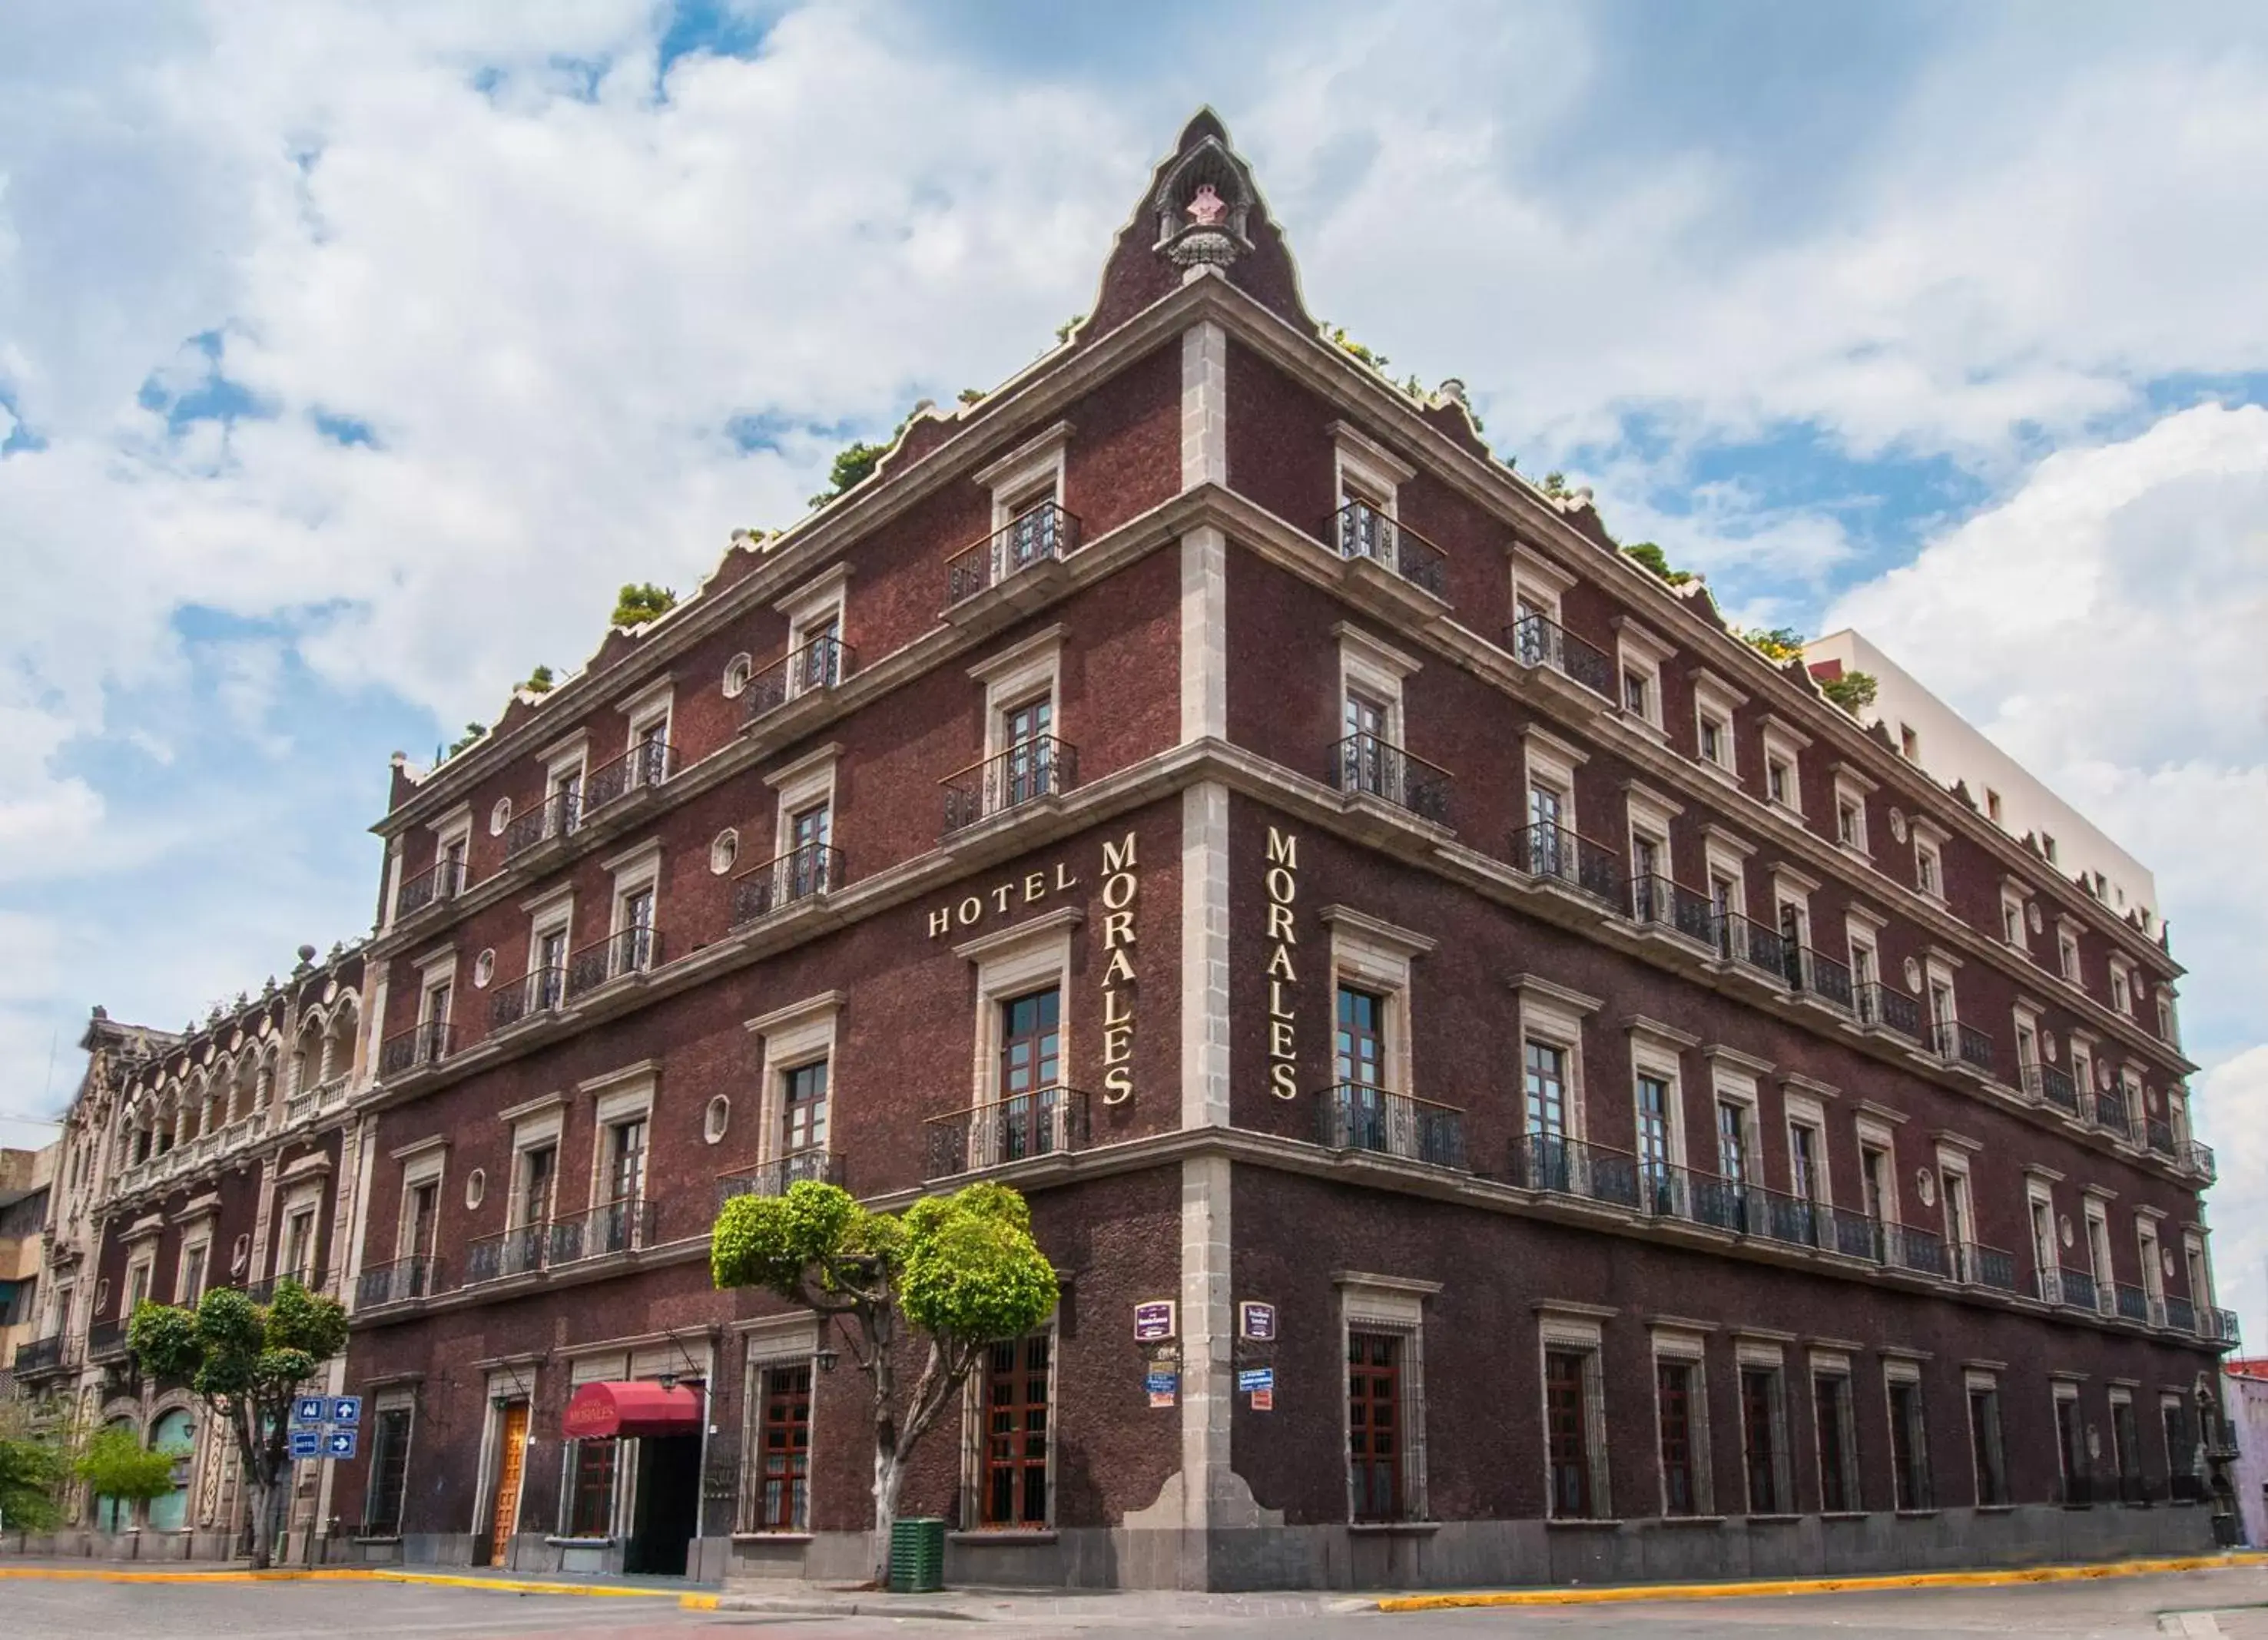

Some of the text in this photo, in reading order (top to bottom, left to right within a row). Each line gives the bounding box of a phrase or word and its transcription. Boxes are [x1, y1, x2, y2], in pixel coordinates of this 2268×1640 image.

[928, 862, 1077, 938] HOTEL
[1100, 831, 1138, 1106] MORALES
[1266, 826, 1298, 1101] MORALES
